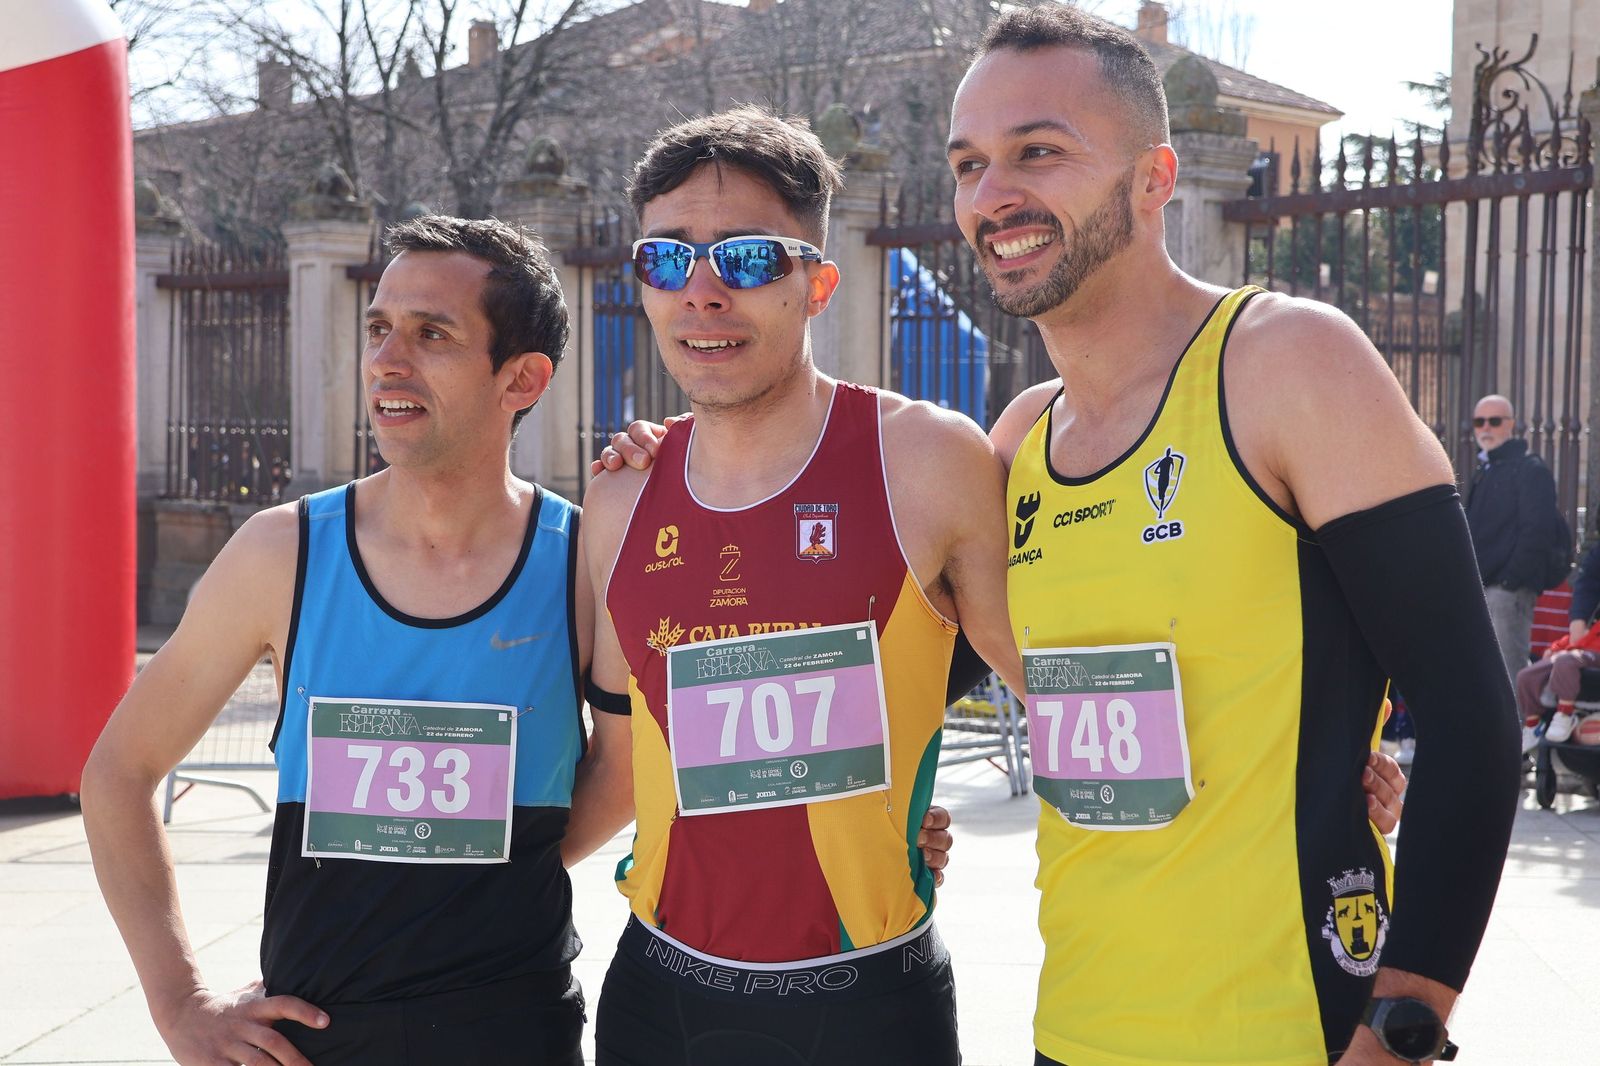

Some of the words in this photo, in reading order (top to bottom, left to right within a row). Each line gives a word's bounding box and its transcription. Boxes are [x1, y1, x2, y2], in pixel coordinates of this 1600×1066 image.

[795, 504, 815, 512] CIUDAD
[815, 504, 823, 512] DE
[823, 504, 838, 512] TORO
[1053, 511, 1074, 528] CCI
[1074, 500, 1115, 523] SPORT
[1143, 522, 1182, 542] GCB
[645, 556, 685, 573] austral
[710, 597, 748, 607] ZAMORA
[706, 644, 756, 657] Carrera
[780, 655, 803, 663] Catedral
[813, 650, 843, 659] ZAMORA
[803, 658, 834, 666] FEBRERO
[1032, 657, 1071, 666] Carrera
[351, 705, 401, 716] Carrera
[707, 676, 836, 757] 707
[1036, 699, 1141, 774] 748
[347, 744, 470, 814] 733
[646, 937, 738, 992] NIKE
[744, 965, 858, 995] PRO
